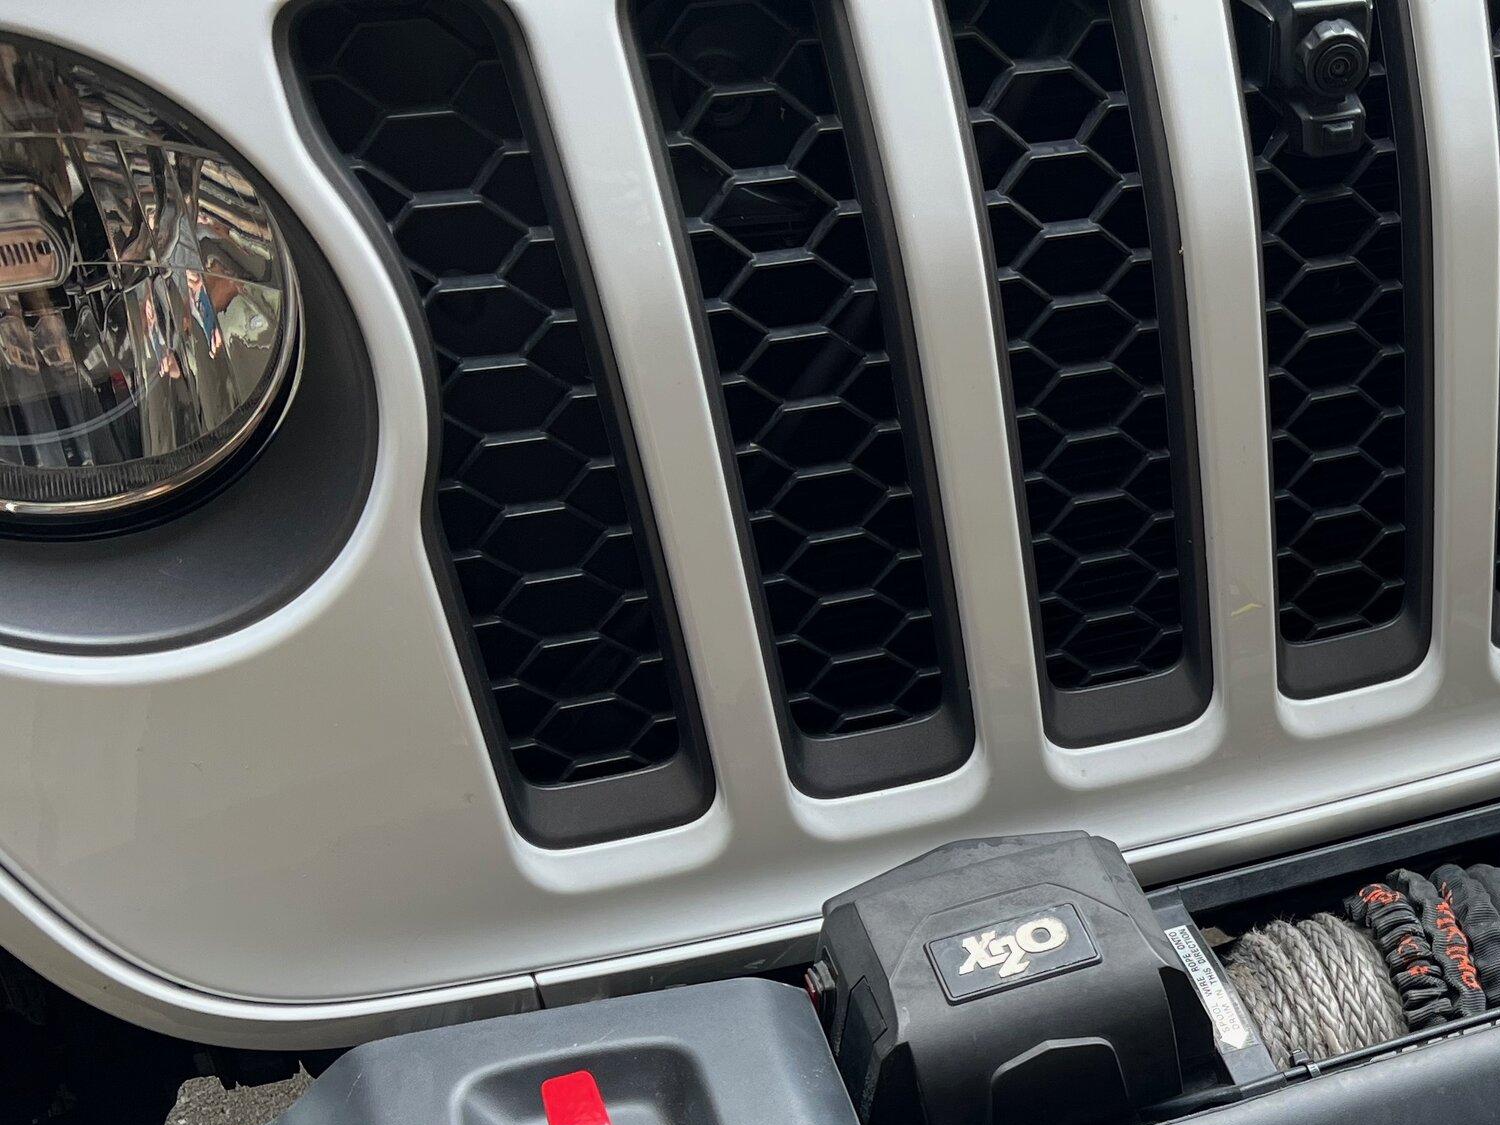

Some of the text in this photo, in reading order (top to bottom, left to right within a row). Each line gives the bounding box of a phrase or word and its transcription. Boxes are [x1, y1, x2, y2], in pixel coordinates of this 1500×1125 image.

[1177, 928, 1206, 965] DIRECTION
[1168, 931, 1231, 1033] SPOOL WIRE ROPE ONTO
[1202, 968, 1217, 986] THIS
[1222, 1003, 1240, 1031] DRUM
